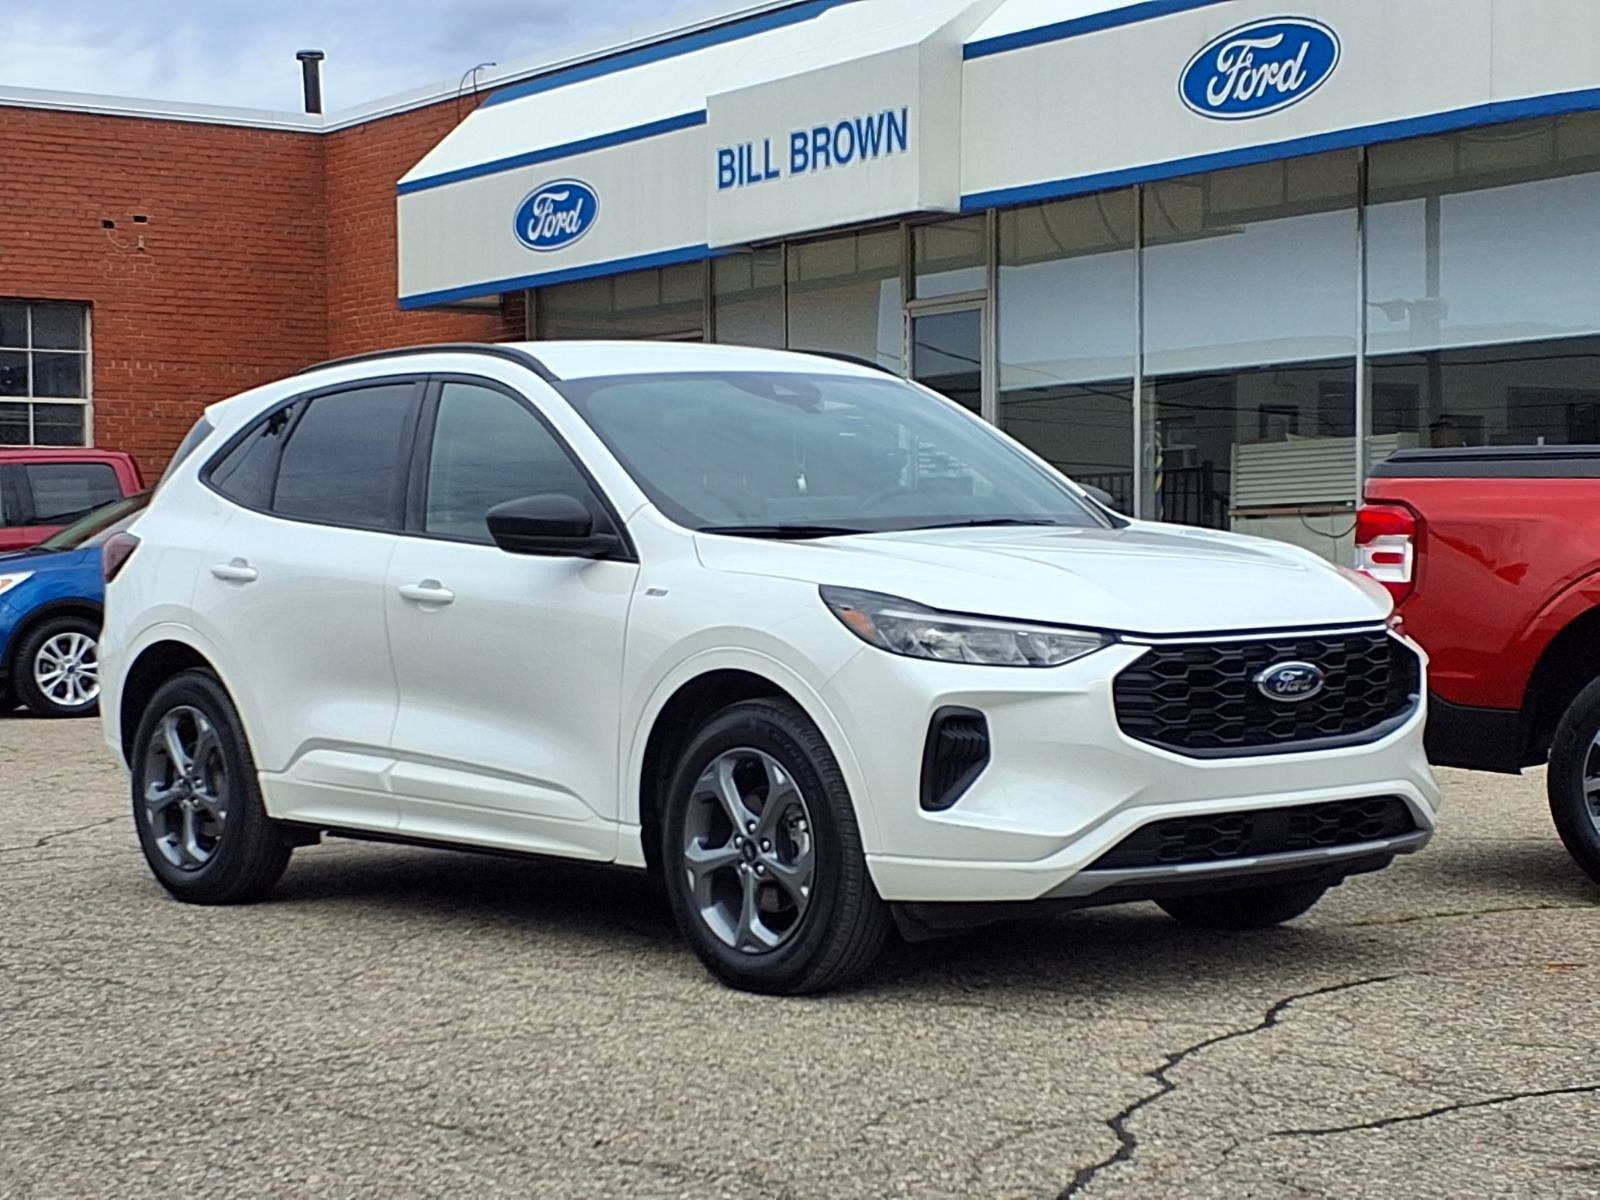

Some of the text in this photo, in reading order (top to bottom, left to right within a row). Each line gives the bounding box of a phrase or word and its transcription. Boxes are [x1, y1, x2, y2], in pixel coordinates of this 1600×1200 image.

[1207, 32, 1310, 106] Ford
[718, 107, 908, 190] BILL BROWN
[527, 190, 583, 239] Ford
[1276, 670, 1314, 692] Ford
